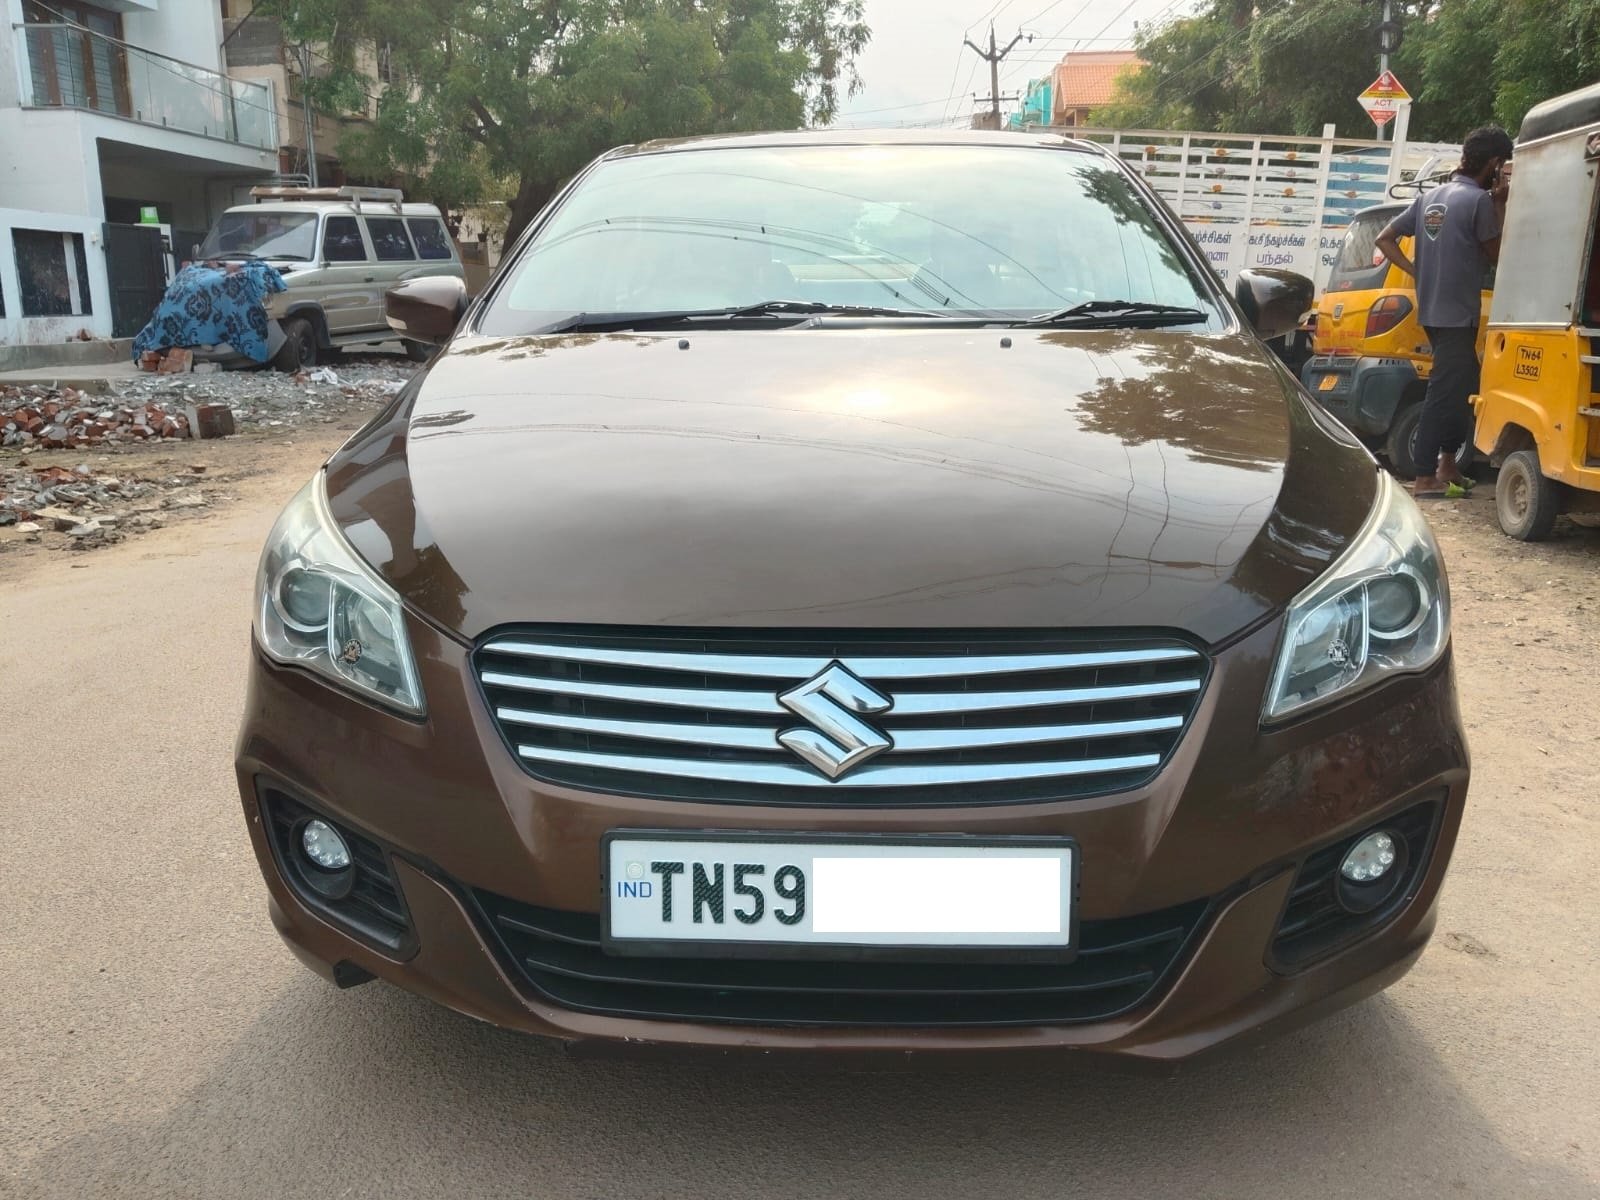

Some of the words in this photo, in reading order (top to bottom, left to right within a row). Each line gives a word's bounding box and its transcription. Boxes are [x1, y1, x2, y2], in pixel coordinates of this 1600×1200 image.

[1374, 98, 1393, 107] ACT
[1256, 250, 1294, 266] பந்தல்
[617, 881, 652, 898] IND
[651, 861, 806, 926] TN59
